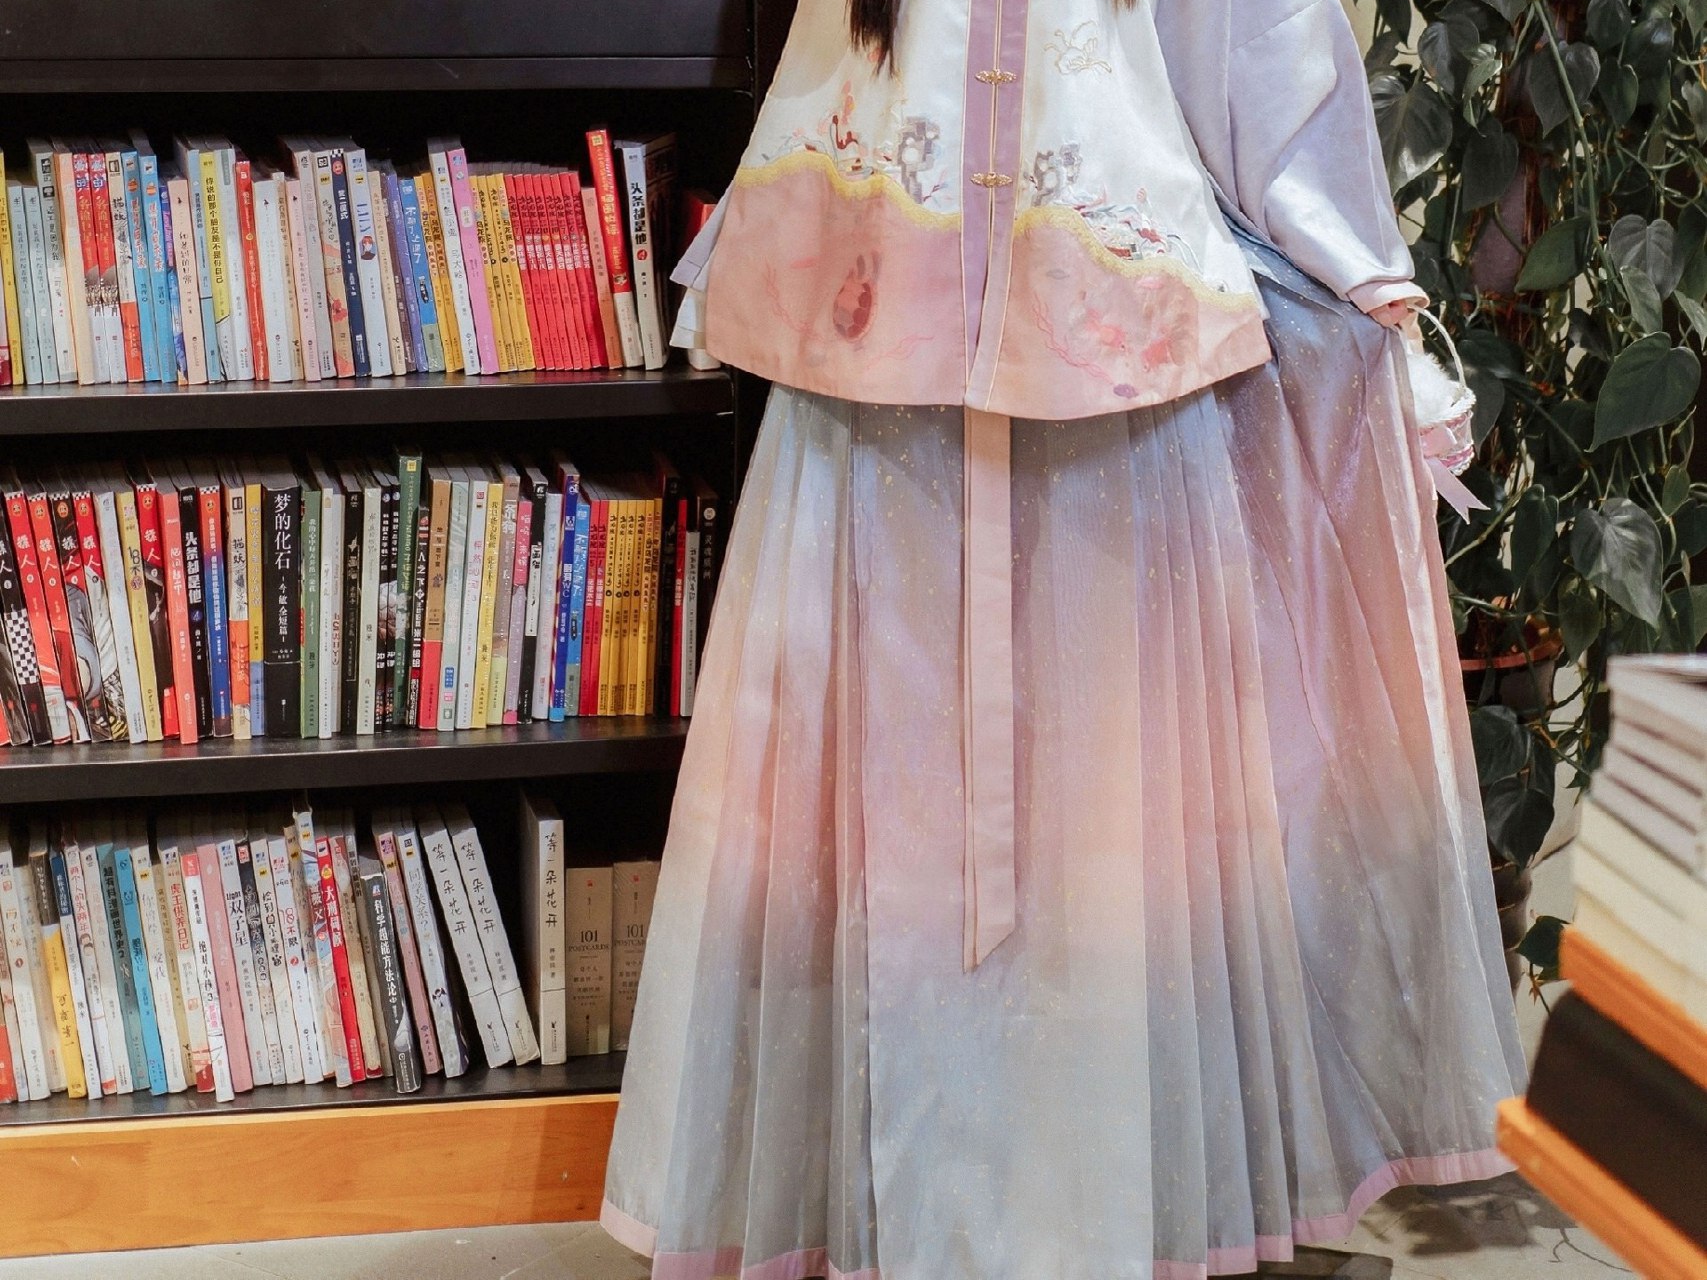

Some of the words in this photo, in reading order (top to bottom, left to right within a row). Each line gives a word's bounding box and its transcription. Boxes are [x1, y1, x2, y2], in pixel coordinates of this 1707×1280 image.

[186, 532, 202, 604] 头条都是他
[274, 493, 292, 570] 梦的化石
[432, 843, 467, 936] 等一朵花开
[461, 841, 496, 934] 等一朵花开
[545, 832, 558, 928] 等一朵花开
[229, 900, 249, 948] 双子星
[580, 930, 598, 943] 101
[626, 924, 644, 938] 101
